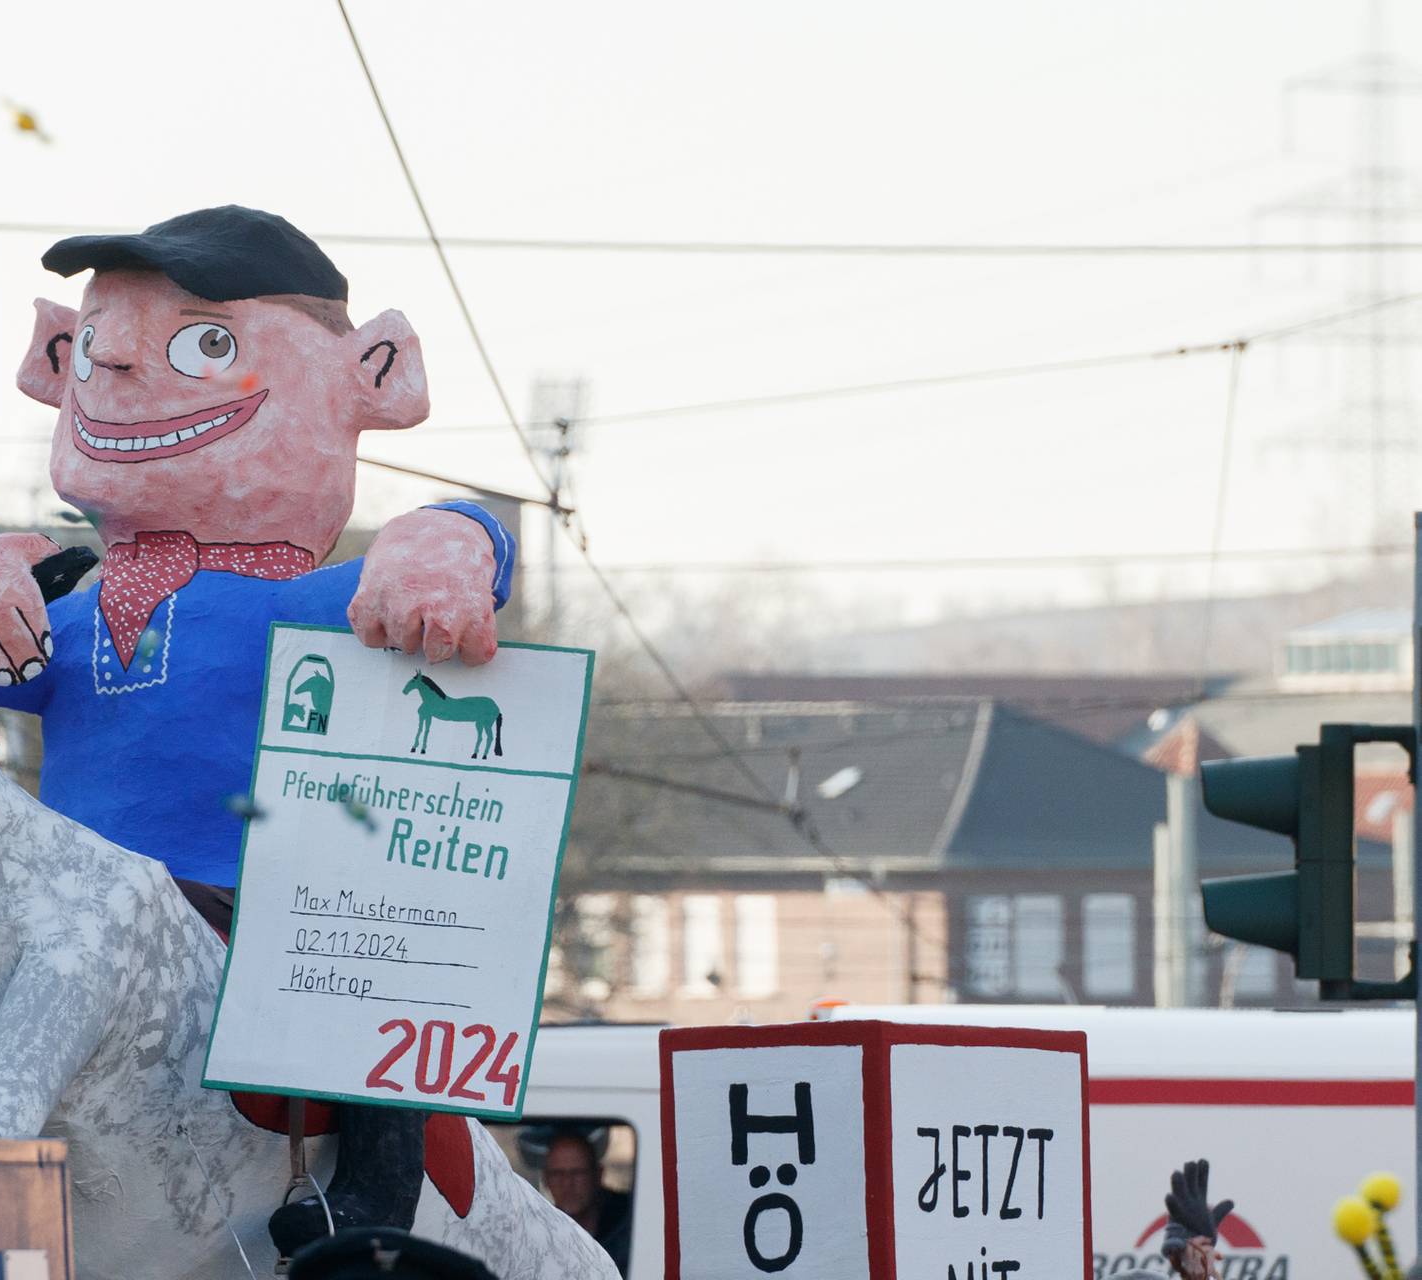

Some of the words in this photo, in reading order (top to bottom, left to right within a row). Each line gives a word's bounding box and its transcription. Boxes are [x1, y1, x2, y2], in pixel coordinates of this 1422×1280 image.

[306, 709, 329, 734] FN
[282, 769, 504, 824] Pferdeführerschein
[386, 817, 509, 881] Reiten
[293, 884, 331, 911] Max
[336, 889, 458, 925] Mustermann
[294, 928, 408, 960] 02.11.2024
[289, 963, 373, 1001] Höntrop
[365, 1018, 521, 1106] 2024
[916, 1124, 1055, 1220] JETZT
